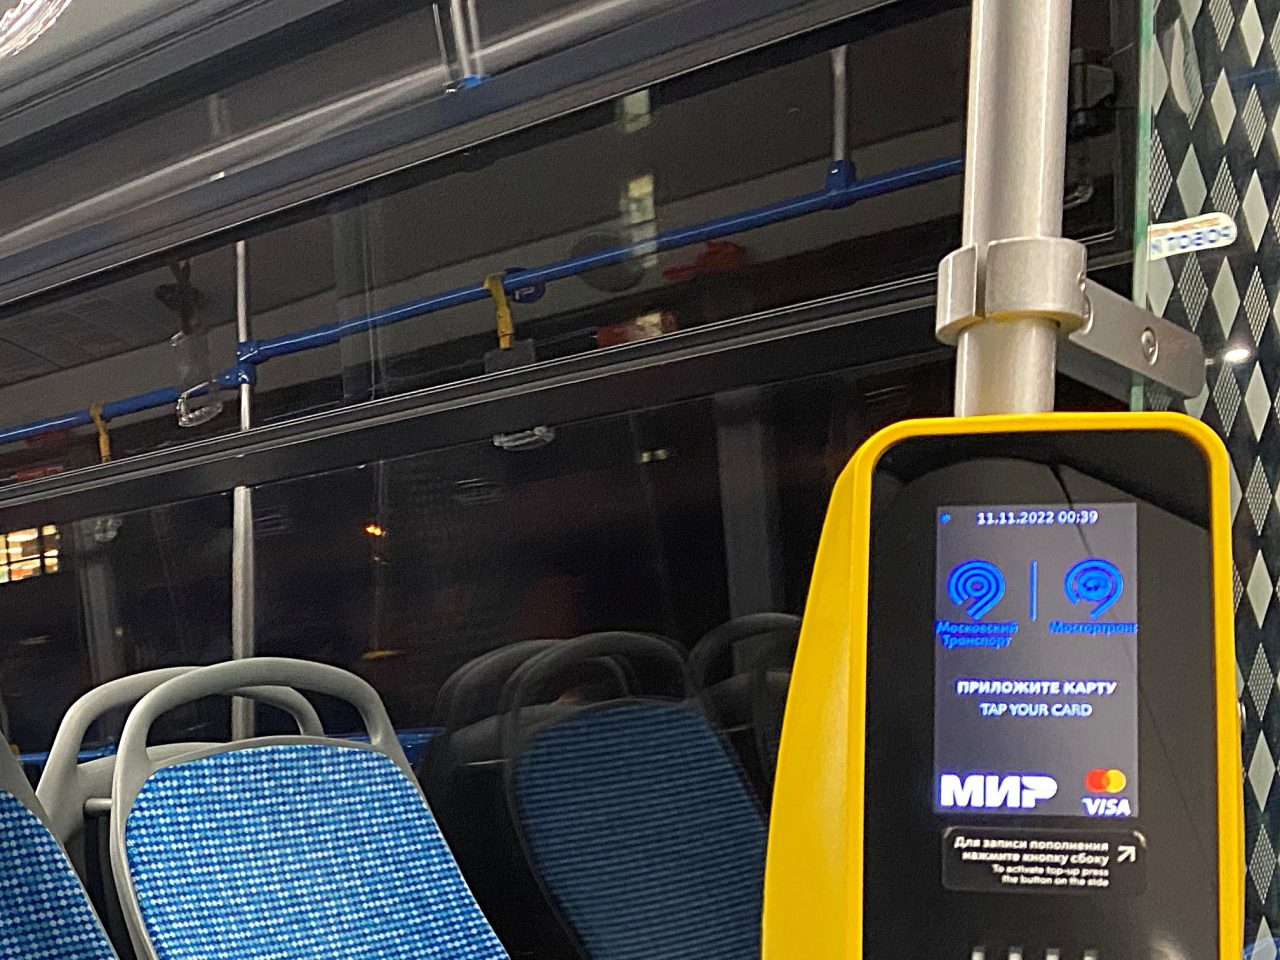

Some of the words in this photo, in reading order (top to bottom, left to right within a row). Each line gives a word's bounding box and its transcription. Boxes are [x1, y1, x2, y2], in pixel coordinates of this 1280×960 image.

[976, 511, 1055, 525] 11.11.2022
[1058, 510, 1099, 525] 00:39
[935, 621, 1019, 634] Московский
[942, 634, 1012, 649] Транспорт
[956, 680, 1060, 695] ПРИЛОЖИТЕ
[1063, 681, 1118, 695] КАРТУ
[979, 703, 1008, 716] TAP
[1009, 703, 1049, 716] YOUR
[1051, 703, 1093, 717] CARD
[940, 774, 1058, 809] МИР
[1083, 798, 1132, 816] VISA
[954, 836, 980, 849] Для
[983, 838, 1027, 849] записи
[1029, 840, 1109, 851] пополнения
[962, 851, 1020, 861] нажмите
[1022, 852, 1069, 866] кнопку
[1071, 852, 1109, 867] сбоку
[991, 864, 1005, 873] To
[1006, 865, 1044, 873] activate
[1046, 865, 1080, 876] top-up
[1082, 867, 1109, 877] press
[1001, 875, 1018, 884] the
[1020, 875, 1052, 884] button
[1054, 876, 1068, 885] on
[1069, 876, 1086, 885] the
[1087, 877, 1109, 887] side
